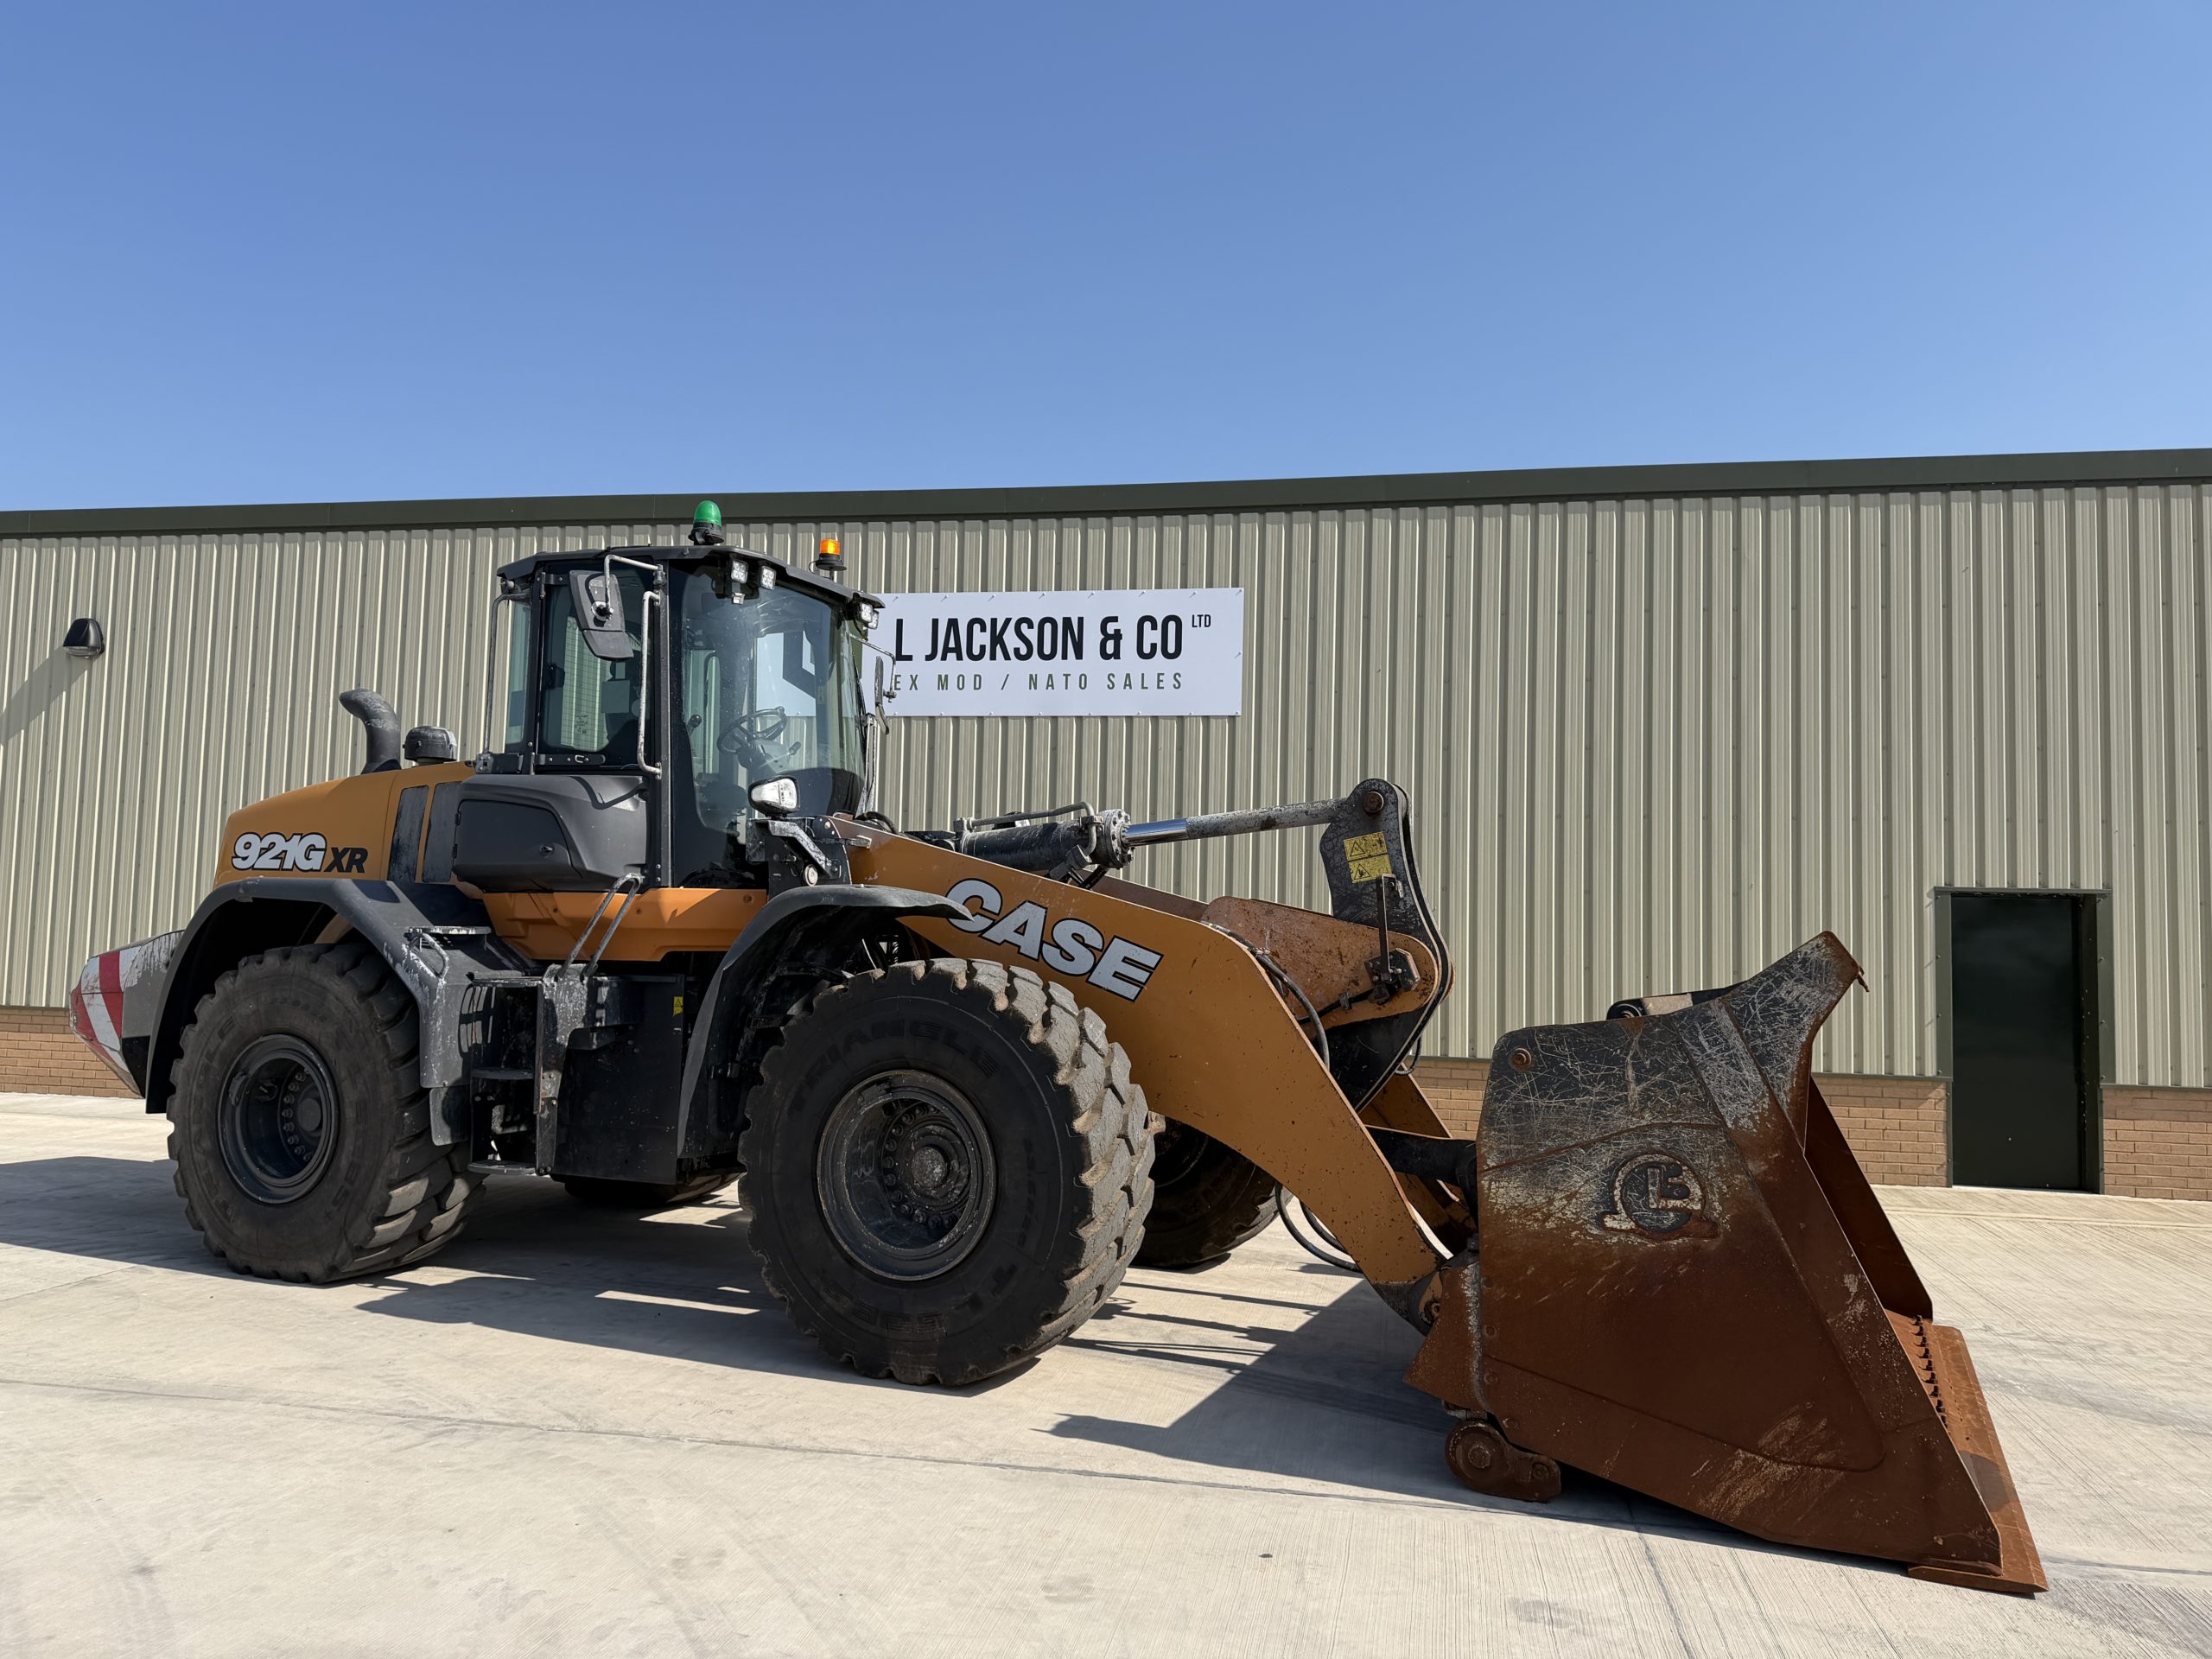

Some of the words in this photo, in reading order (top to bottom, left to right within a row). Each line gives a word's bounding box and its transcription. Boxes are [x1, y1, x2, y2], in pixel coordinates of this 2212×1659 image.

[895, 618, 913, 662] L
[925, 616, 1084, 662] JACKSON
[1099, 615, 1123, 661] &
[1135, 614, 1183, 660] CO
[1192, 613, 1211, 629] LTD
[893, 674, 918, 691] EX
[937, 673, 982, 691] MOD
[1028, 672, 1088, 690] NATO
[1106, 671, 1183, 690] SALES
[232, 832, 327, 873] 921G
[324, 847, 369, 874] XR
[945, 878, 1164, 1002] CASE
[788, 1019, 1000, 1114] TRIANGLE
